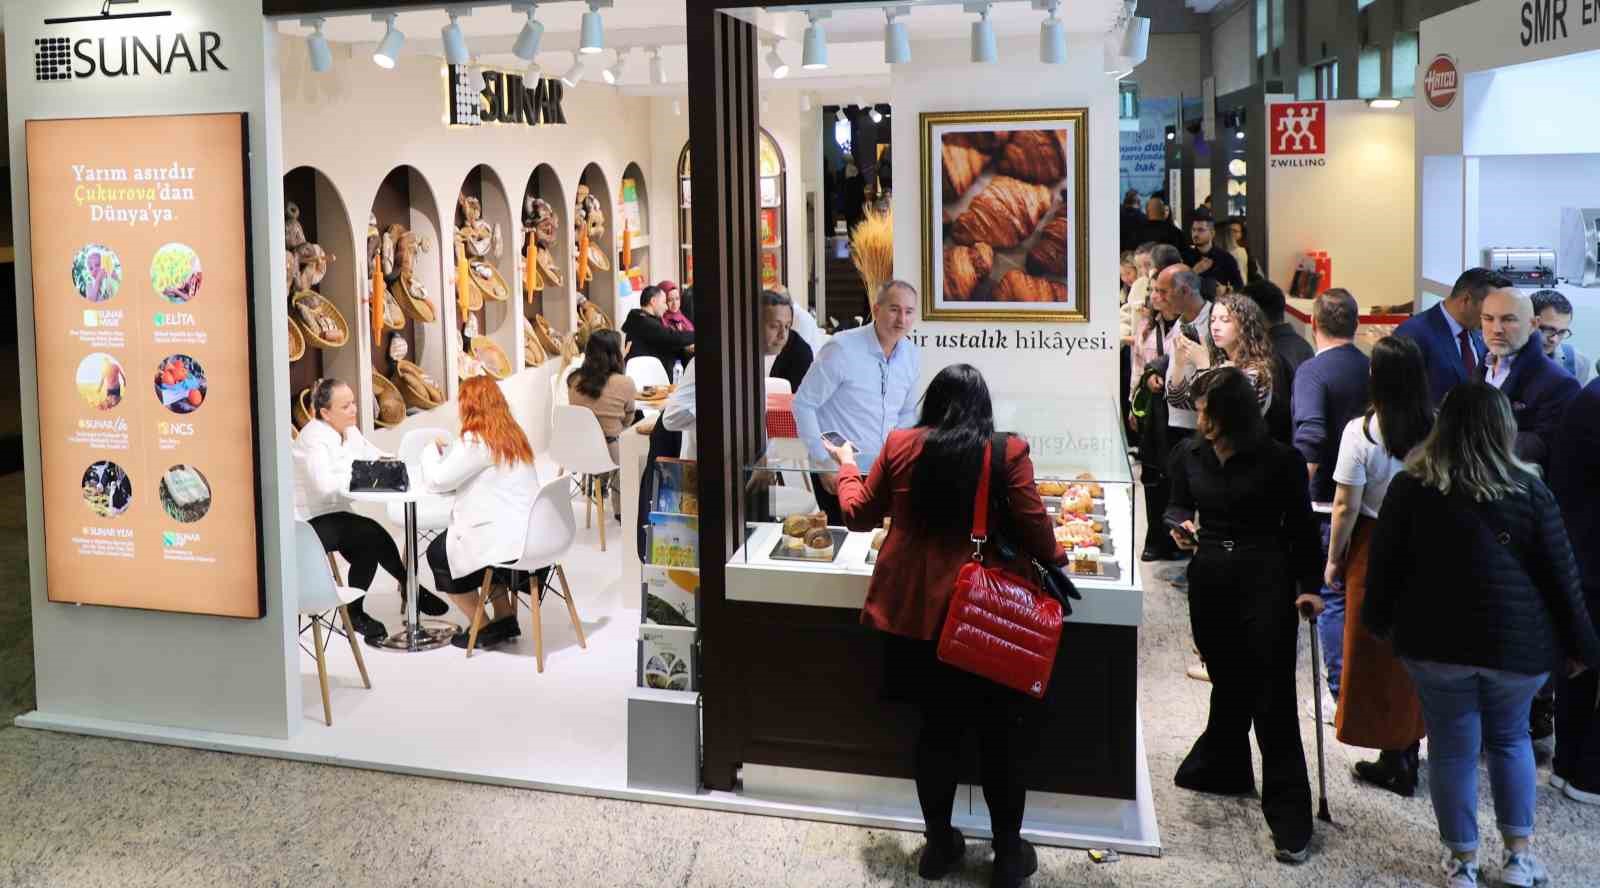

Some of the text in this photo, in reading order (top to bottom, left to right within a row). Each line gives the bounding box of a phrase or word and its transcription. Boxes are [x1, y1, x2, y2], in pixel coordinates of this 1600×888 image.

[1520, 0, 1568, 47] SMR
[73, 31, 228, 78] SUNAR
[480, 70, 567, 126] SUNAR
[72, 160, 195, 181] Yarım asırdır
[1271, 158, 1326, 168] ZWILLING
[74, 182, 194, 206] Çukurova'dan
[935, 328, 1008, 349] ustalık
[1016, 329, 1113, 356] hikâyesi.
[170, 422, 194, 435] NCS
